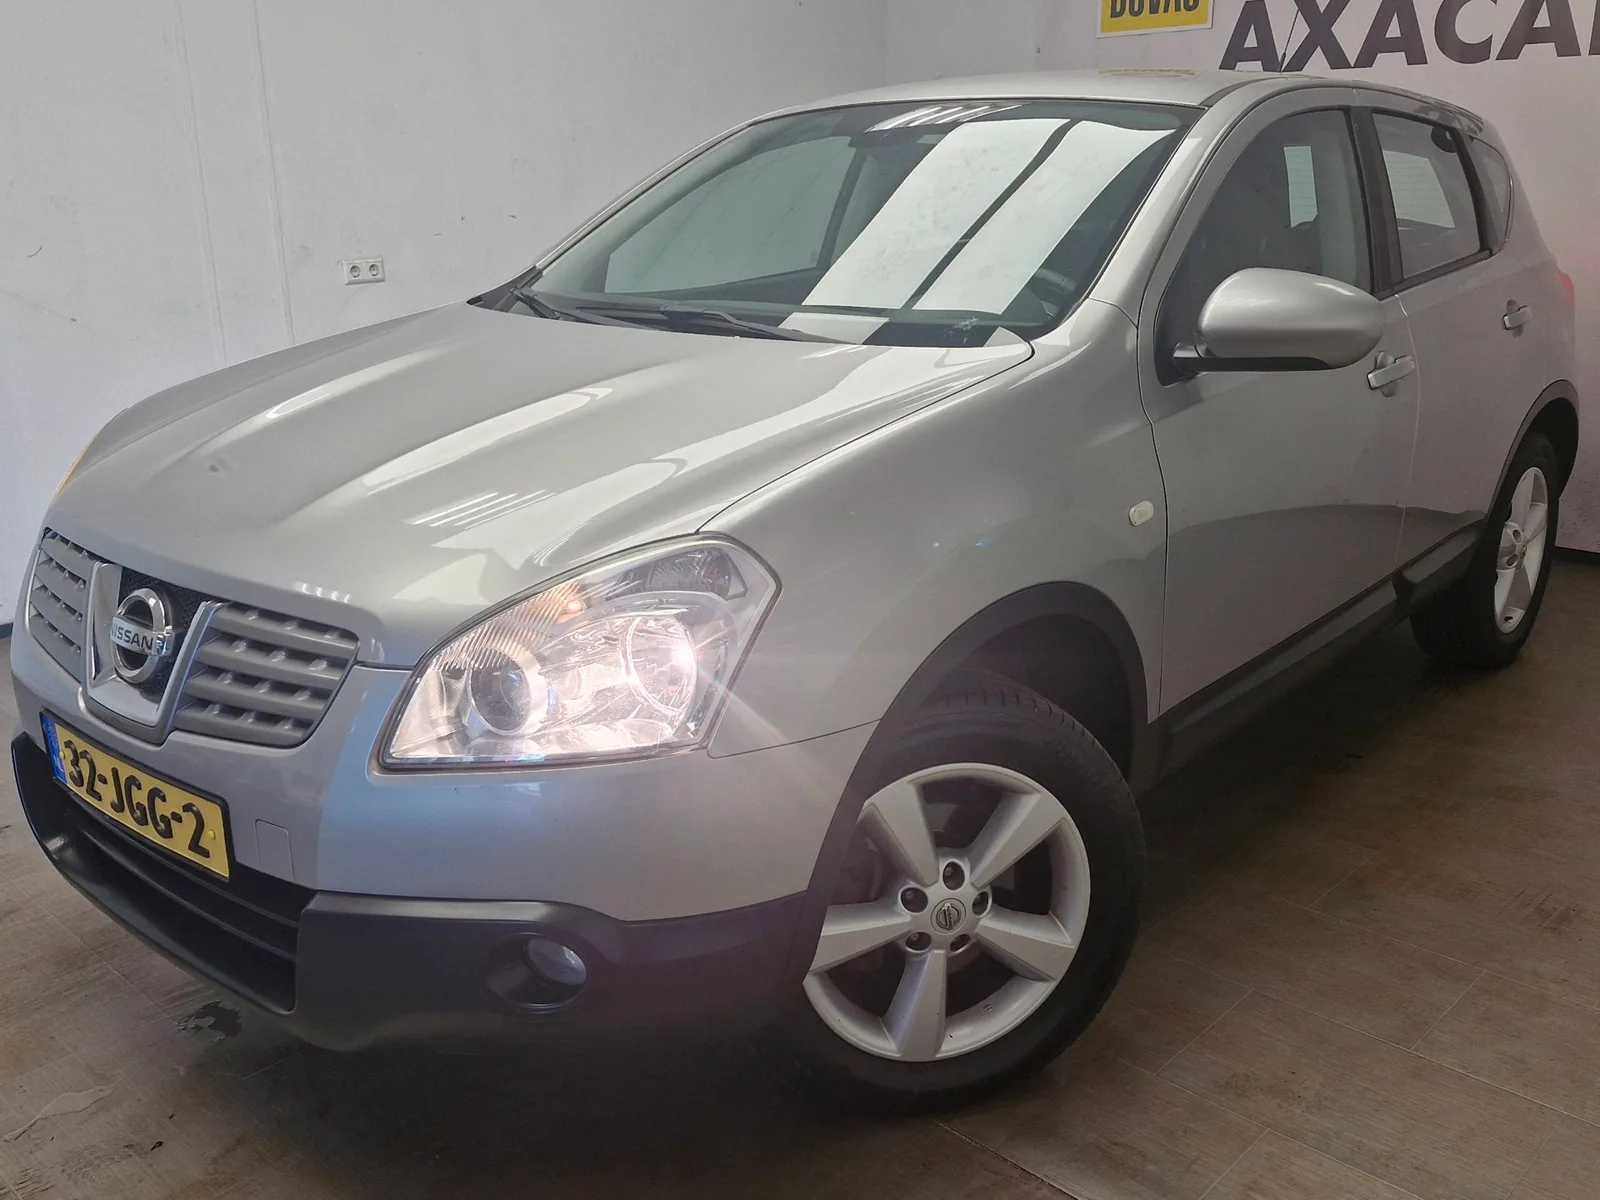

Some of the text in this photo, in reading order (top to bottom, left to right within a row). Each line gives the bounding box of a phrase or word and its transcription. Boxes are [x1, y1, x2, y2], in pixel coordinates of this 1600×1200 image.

[1219, 0, 1600, 71] AXACA
[110, 622, 154, 651] NISSAN
[64, 739, 211, 859] 32-JGG-2
